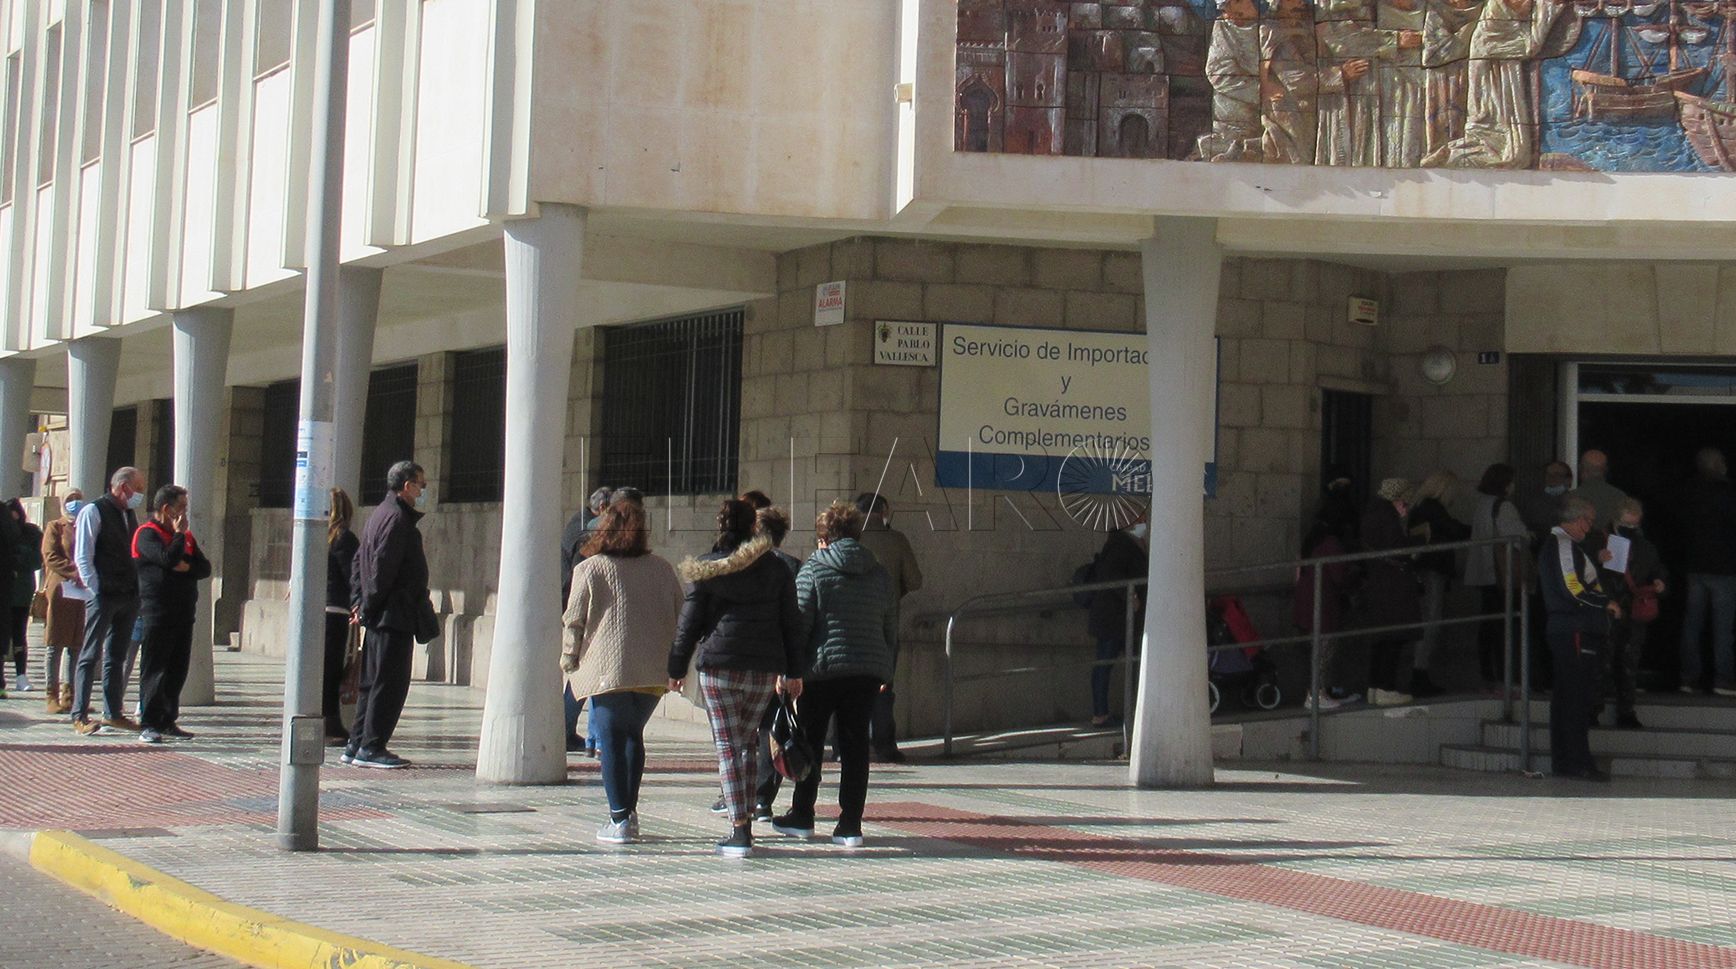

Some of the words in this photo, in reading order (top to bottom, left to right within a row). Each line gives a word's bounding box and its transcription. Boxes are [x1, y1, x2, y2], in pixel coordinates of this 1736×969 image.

[898, 326, 928, 336] CALLE
[898, 339, 930, 349] PABLO
[953, 335, 1031, 359] Servicio
[1036, 341, 1061, 361] de
[1067, 342, 1150, 367] Importac
[880, 351, 928, 361] VALLESCA
[1060, 375, 1072, 394] y
[1003, 397, 1128, 422] Gravámenes
[978, 424, 1151, 451] Complementarios
[1112, 473, 1152, 493] MEL
